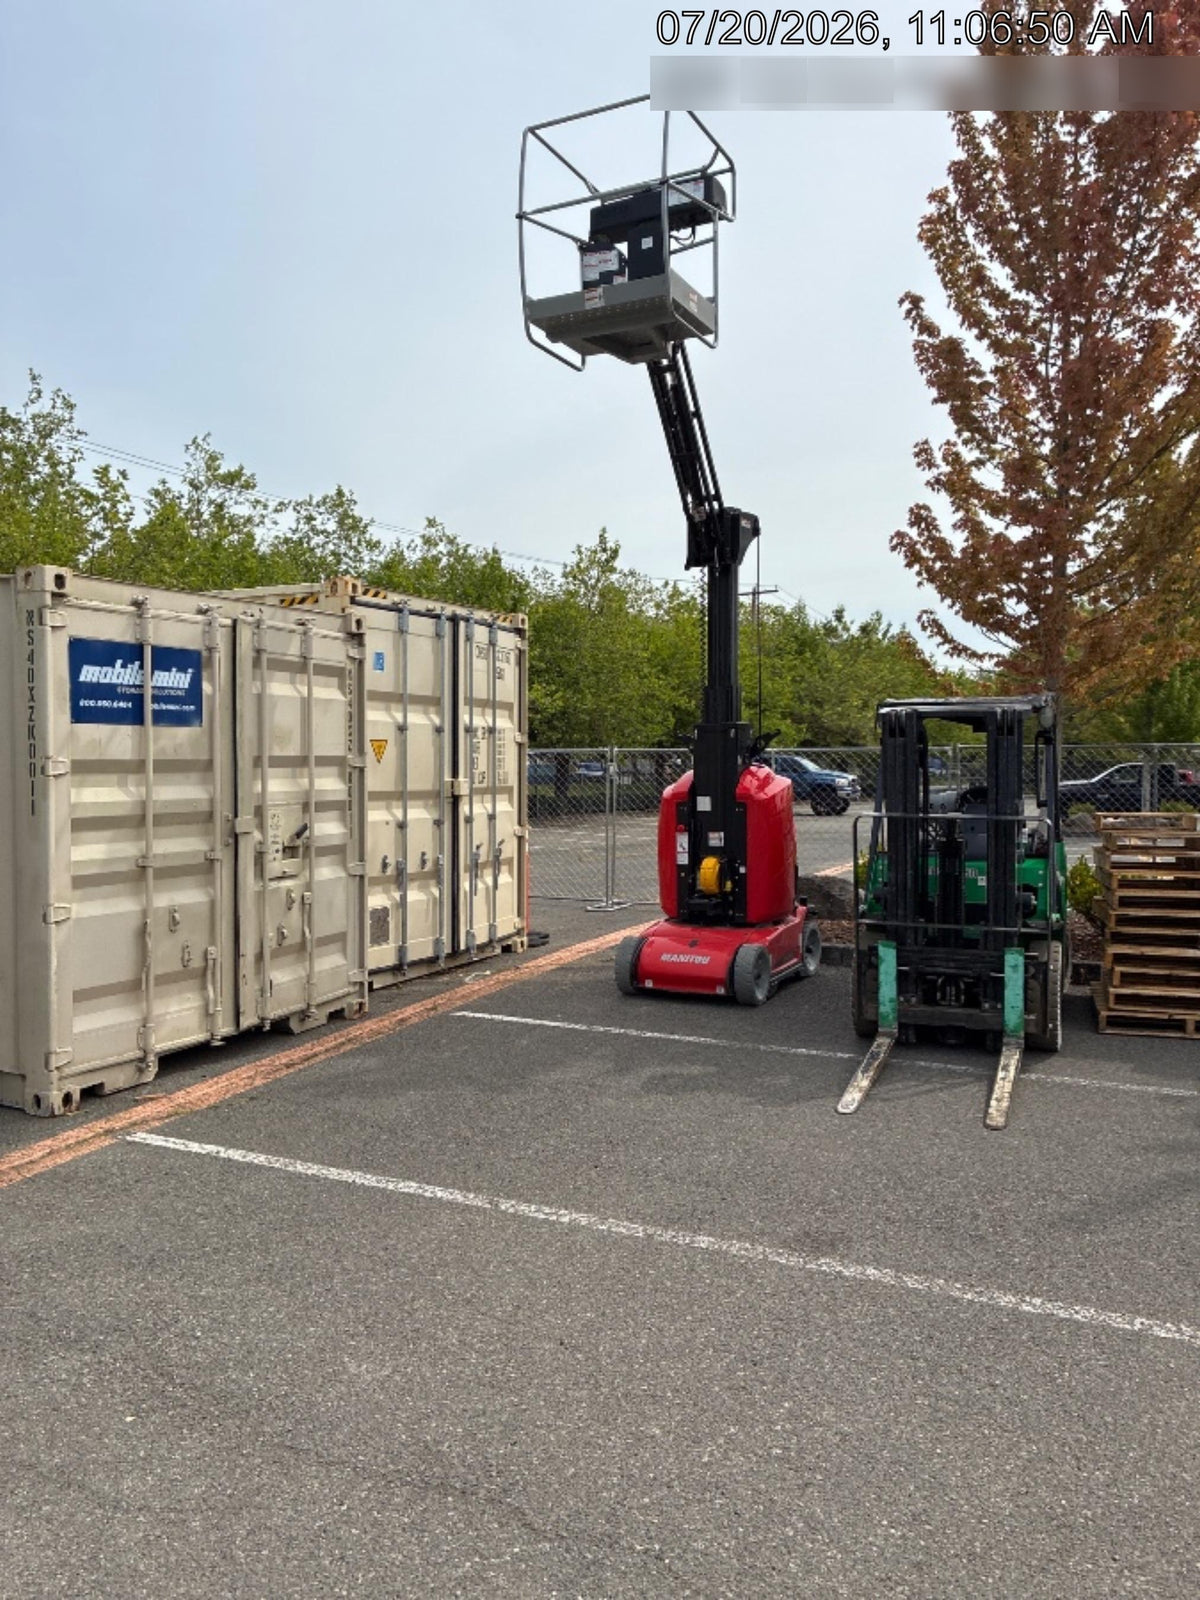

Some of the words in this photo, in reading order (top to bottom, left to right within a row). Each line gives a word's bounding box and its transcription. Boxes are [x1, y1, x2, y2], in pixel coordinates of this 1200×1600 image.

[79, 659, 145, 685] mobile
[151, 667, 195, 688] mini
[116, 685, 145, 695] STORAG
[661, 953, 711, 965] MANITOU
